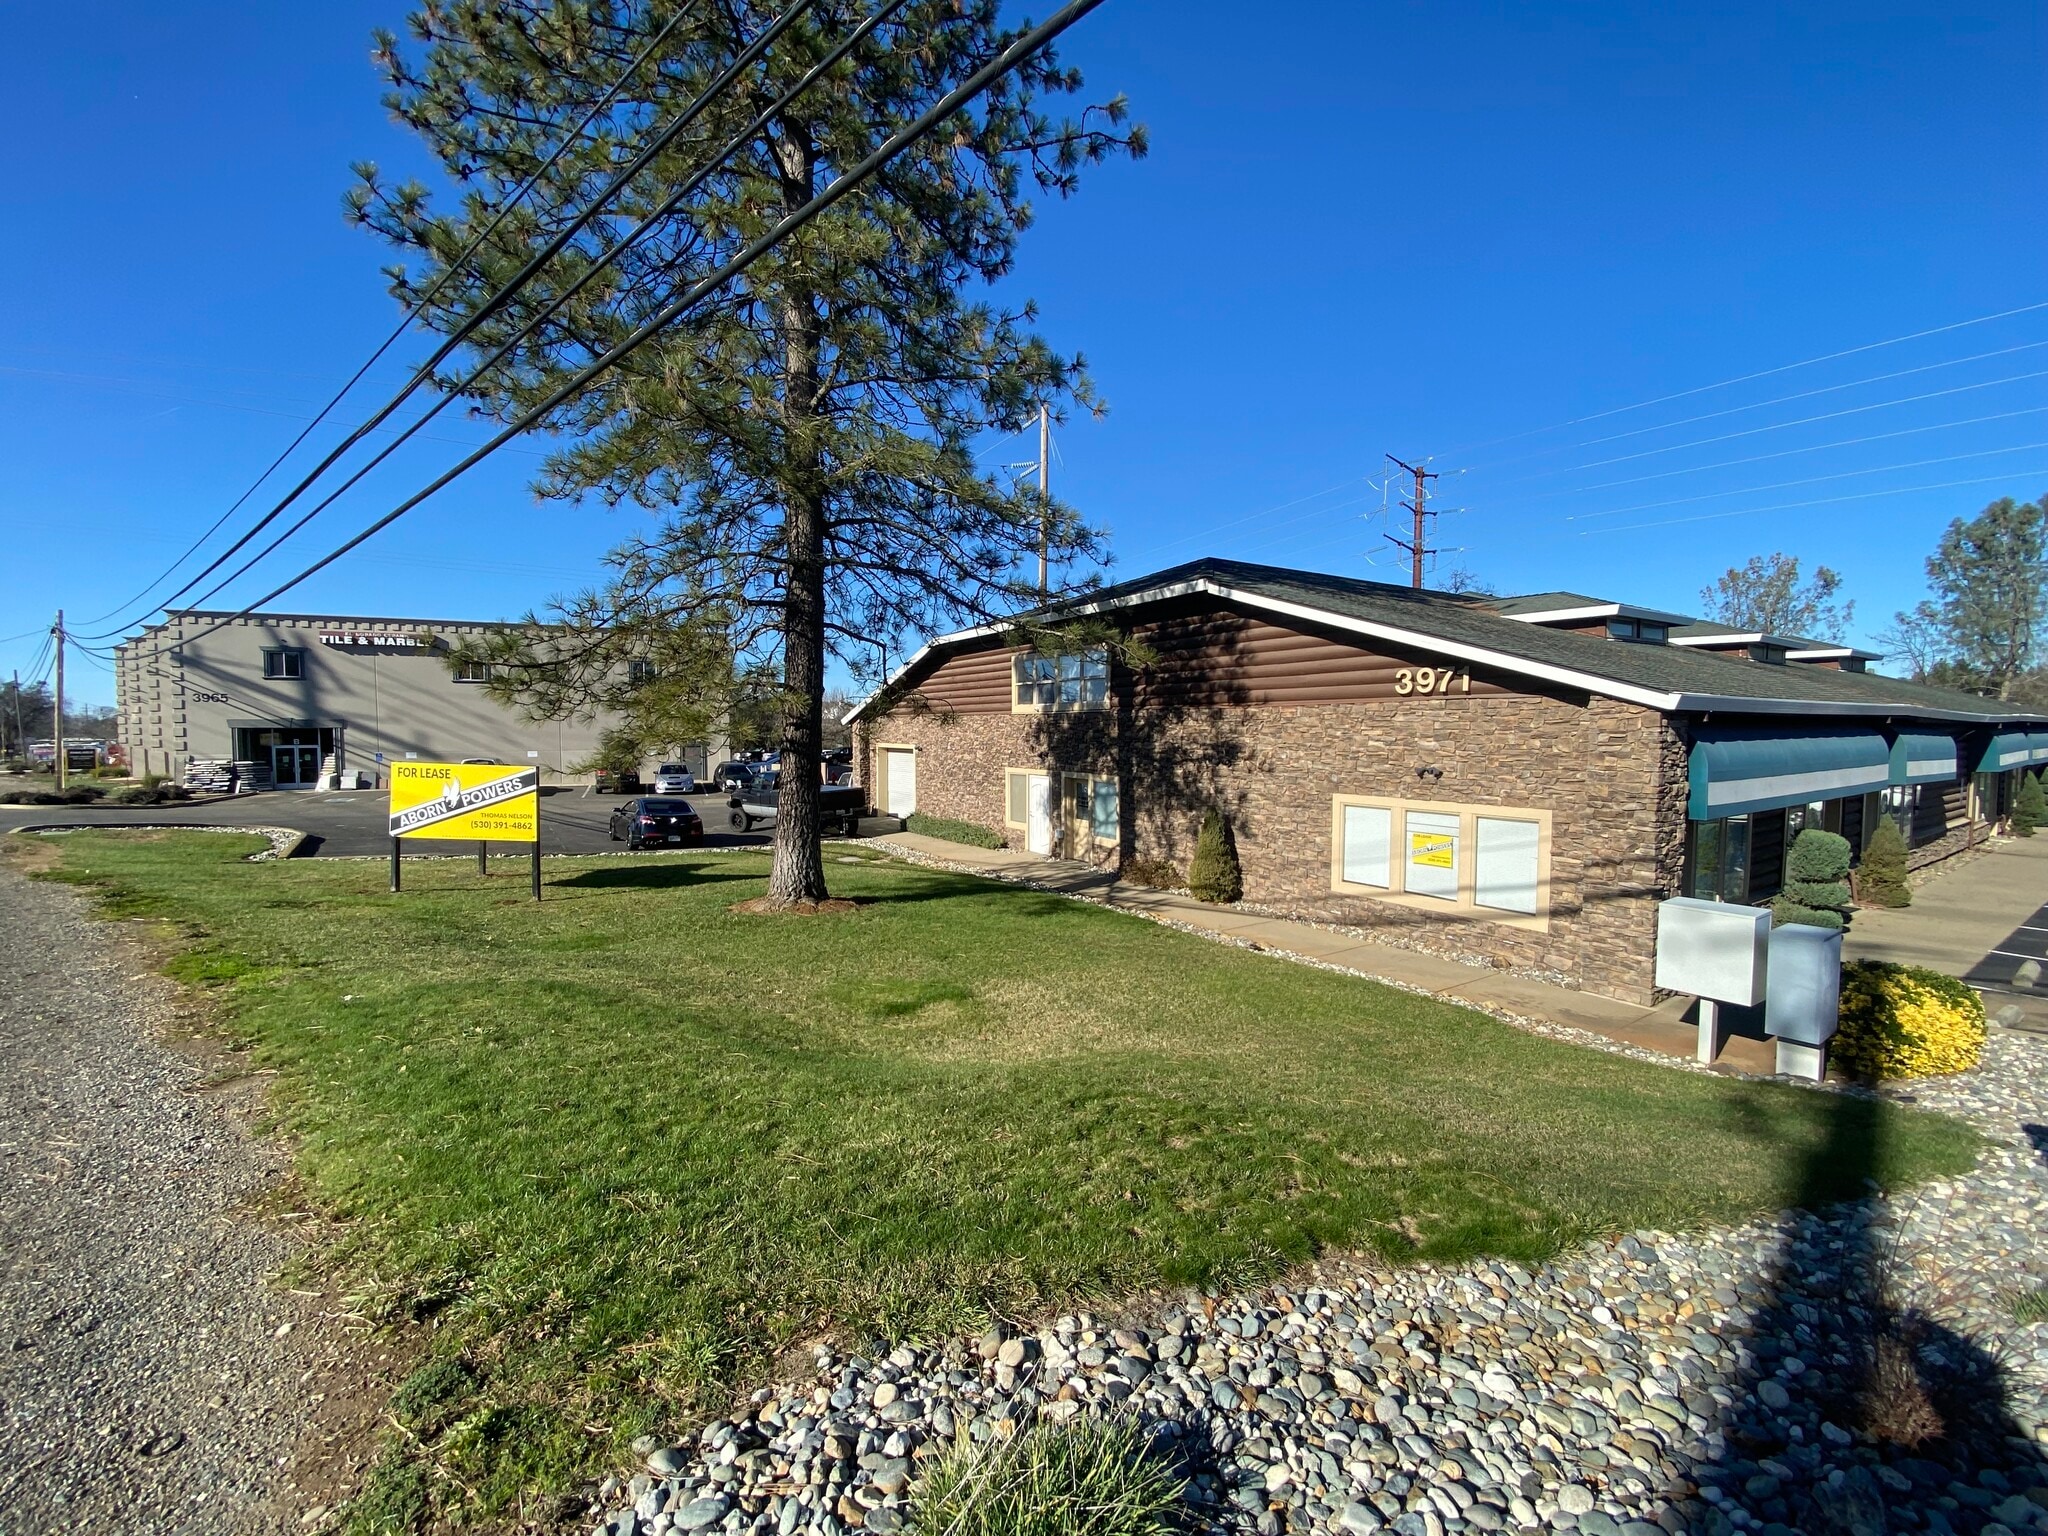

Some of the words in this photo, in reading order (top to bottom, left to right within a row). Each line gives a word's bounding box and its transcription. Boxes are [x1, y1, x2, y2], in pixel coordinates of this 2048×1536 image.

[319, 635, 353, 645] TILE
[357, 636, 369, 645] &
[1394, 665, 1470, 695] 3971
[192, 693, 229, 703] 3965
[397, 767, 418, 778] FOR
[420, 767, 451, 779] LEASE
[399, 800, 448, 828] ABORN
[461, 777, 523, 807] POWERS
[470, 820, 492, 830] (530)
[493, 821, 533, 830] 391-4862
